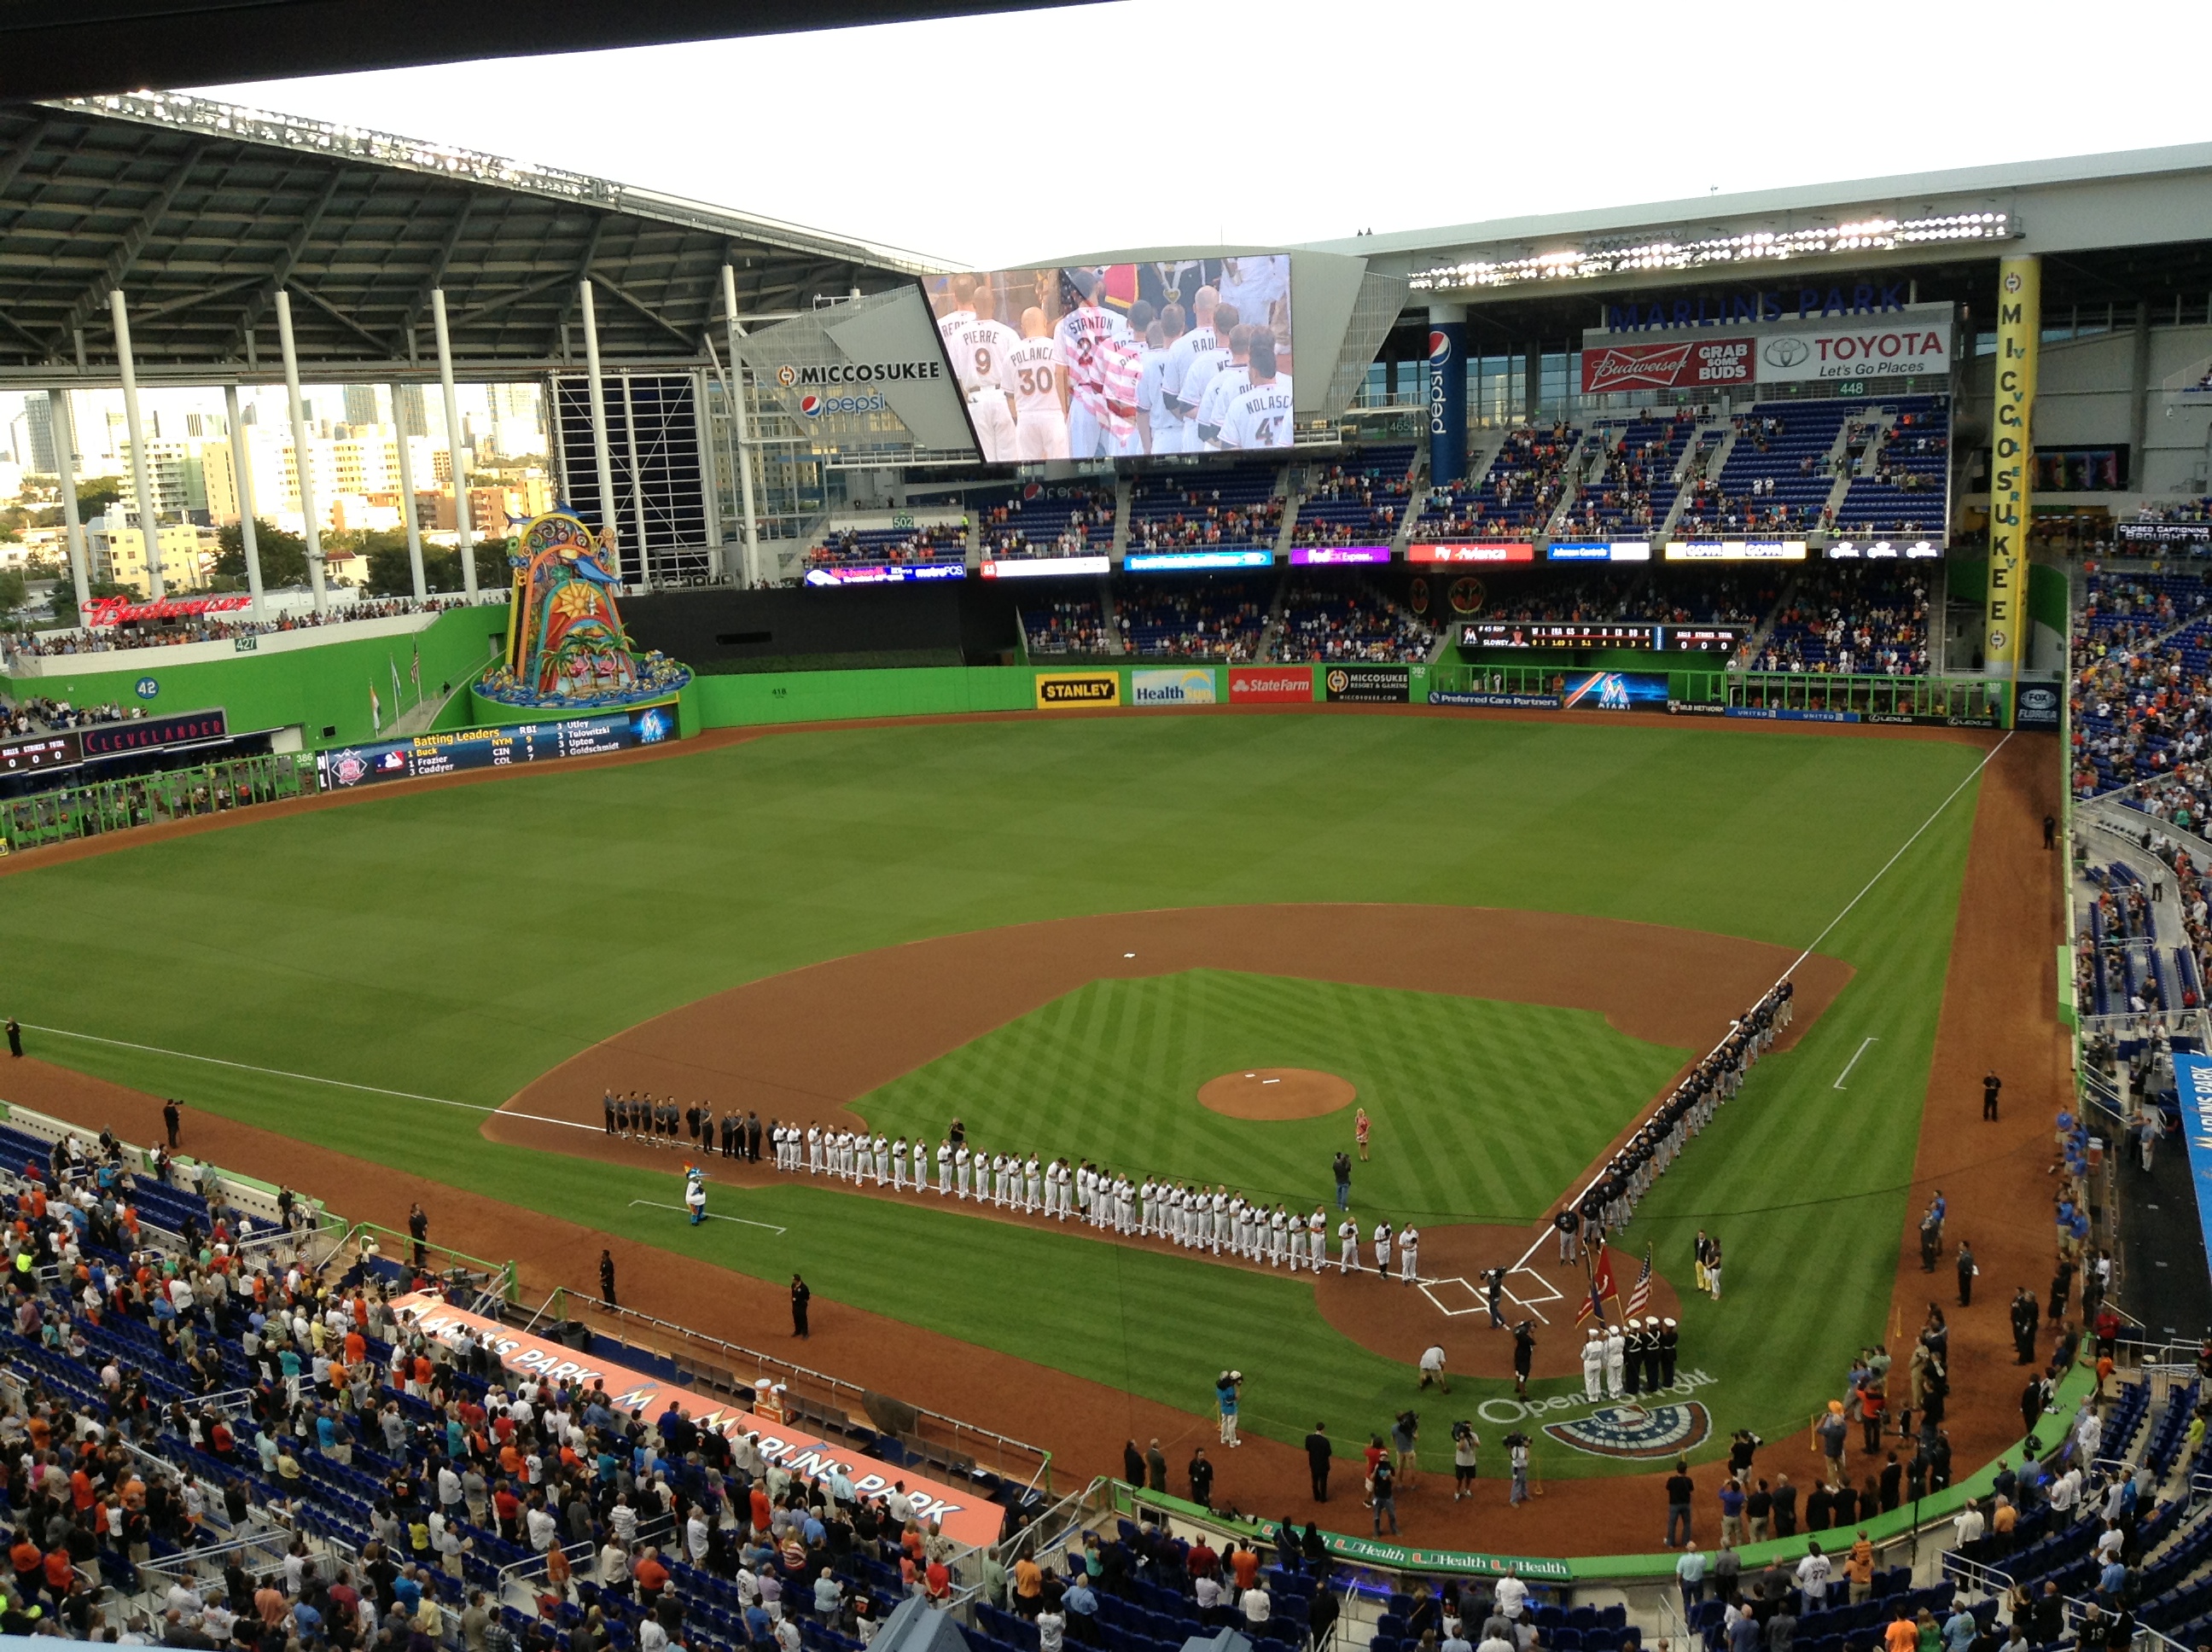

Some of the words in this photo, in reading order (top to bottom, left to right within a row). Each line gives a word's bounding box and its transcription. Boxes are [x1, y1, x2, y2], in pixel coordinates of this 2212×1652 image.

[1609, 290, 1782, 333] MARLINS
[1799, 282, 1905, 319] PARK
[1069, 316, 1114, 334] STANTON
[963, 330, 999, 345] PIERRE
[1698, 344, 1748, 359] GRAB
[1815, 331, 1943, 361] TOYOTA
[975, 348, 991, 375] 9
[1010, 346, 1053, 366] POLANC
[1708, 358, 1739, 367] SOME
[801, 362, 939, 383] MICCOSUKEE
[1592, 358, 1687, 379] Budweiser
[1698, 365, 1746, 381] BUDS
[1819, 364, 1851, 377] Let's
[1855, 364, 1874, 375] Go
[1877, 362, 1924, 374] Places
[1018, 366, 1052, 395] 30
[1840, 382, 1864, 394] 448
[825, 393, 885, 416] pepsi
[1430, 369, 1447, 434] pepsi
[894, 517, 913, 527] 502
[2126, 532, 2187, 541] BROUGHT
[81, 593, 253, 627] Budweiser
[236, 638, 254, 650] 427
[1350, 674, 1408, 683] MICCOSUKEE
[137, 683, 156, 695] 42
[1046, 683, 1110, 698] STANLEY
[2029, 693, 2048, 701] FOX
[1441, 695, 1488, 704] Preferred
[1489, 696, 1511, 705] Care
[1513, 698, 1557, 707] Partners
[1598, 702, 1631, 711] MIAMI
[86, 720, 222, 753] CLEVELANDER
[413, 733, 454, 747] Batting
[456, 728, 500, 742] Leaders
[519, 724, 538, 735] RBI
[416, 747, 438, 757] Buck
[492, 737, 513, 747] NYM
[9, 759, 16, 768] 0
[32, 754, 39, 764] 0
[55, 751, 61, 760] 0
[296, 753, 313, 763] 386
[417, 755, 448, 766] Frazier
[492, 747, 510, 756] CIN
[418, 762, 455, 776] Cuddyer
[493, 756, 512, 765] COL
[569, 742, 620, 756] Goldschmidt
[512, 1347, 604, 1387] PARK
[2091, 1627, 2105, 1640] 19
